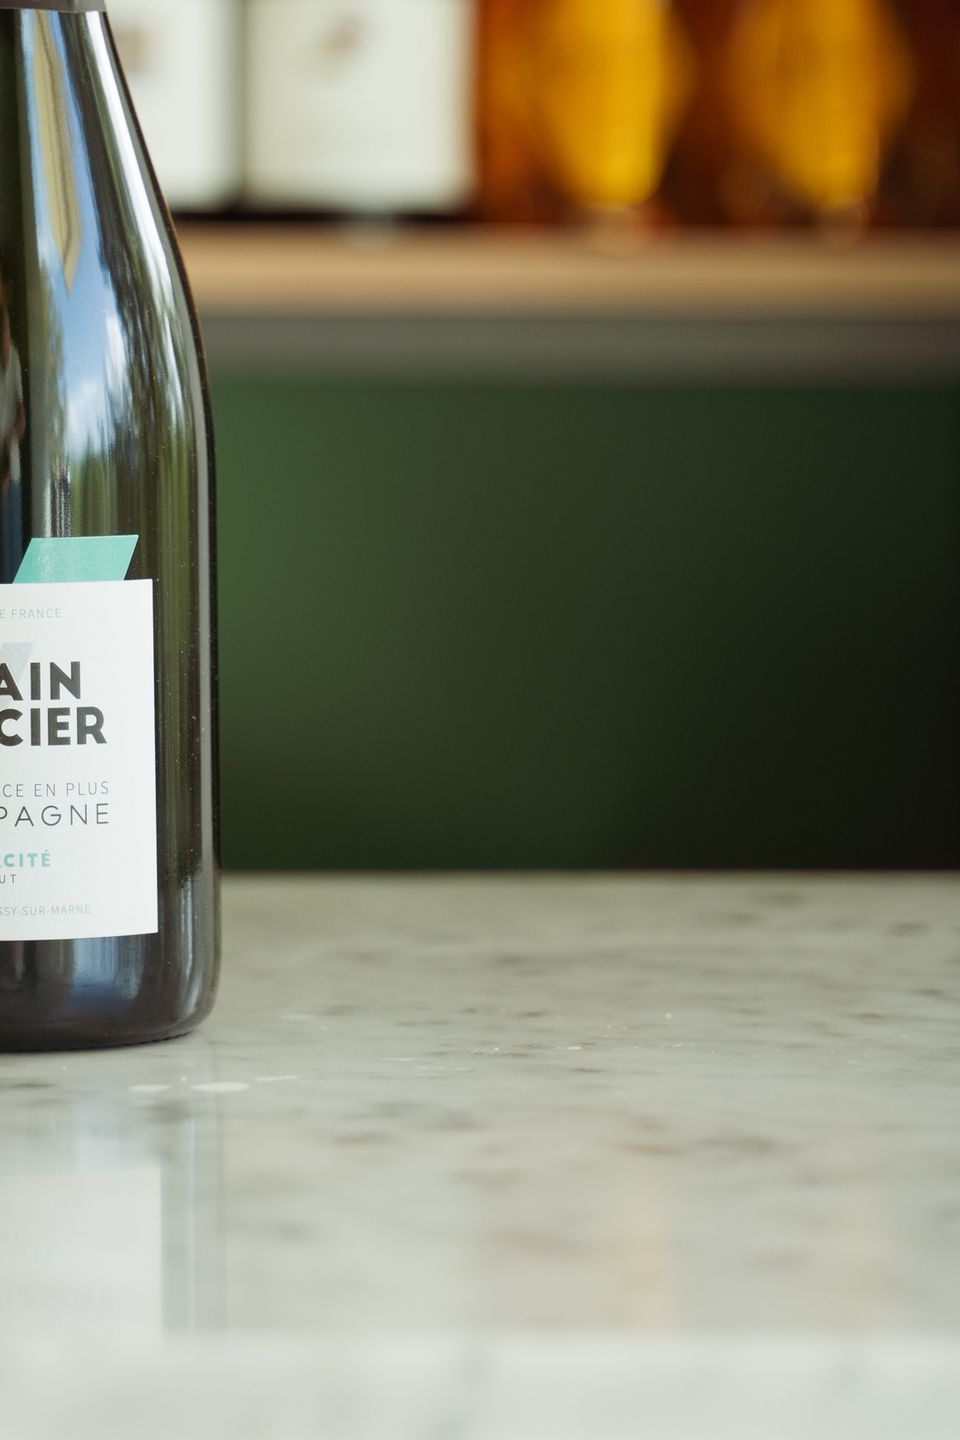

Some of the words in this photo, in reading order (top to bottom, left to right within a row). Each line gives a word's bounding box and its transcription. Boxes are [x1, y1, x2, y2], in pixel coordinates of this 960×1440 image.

[11, 608, 61, 619] FRANCE
[34, 783, 56, 797] EN
[66, 781, 109, 796] PLUS
